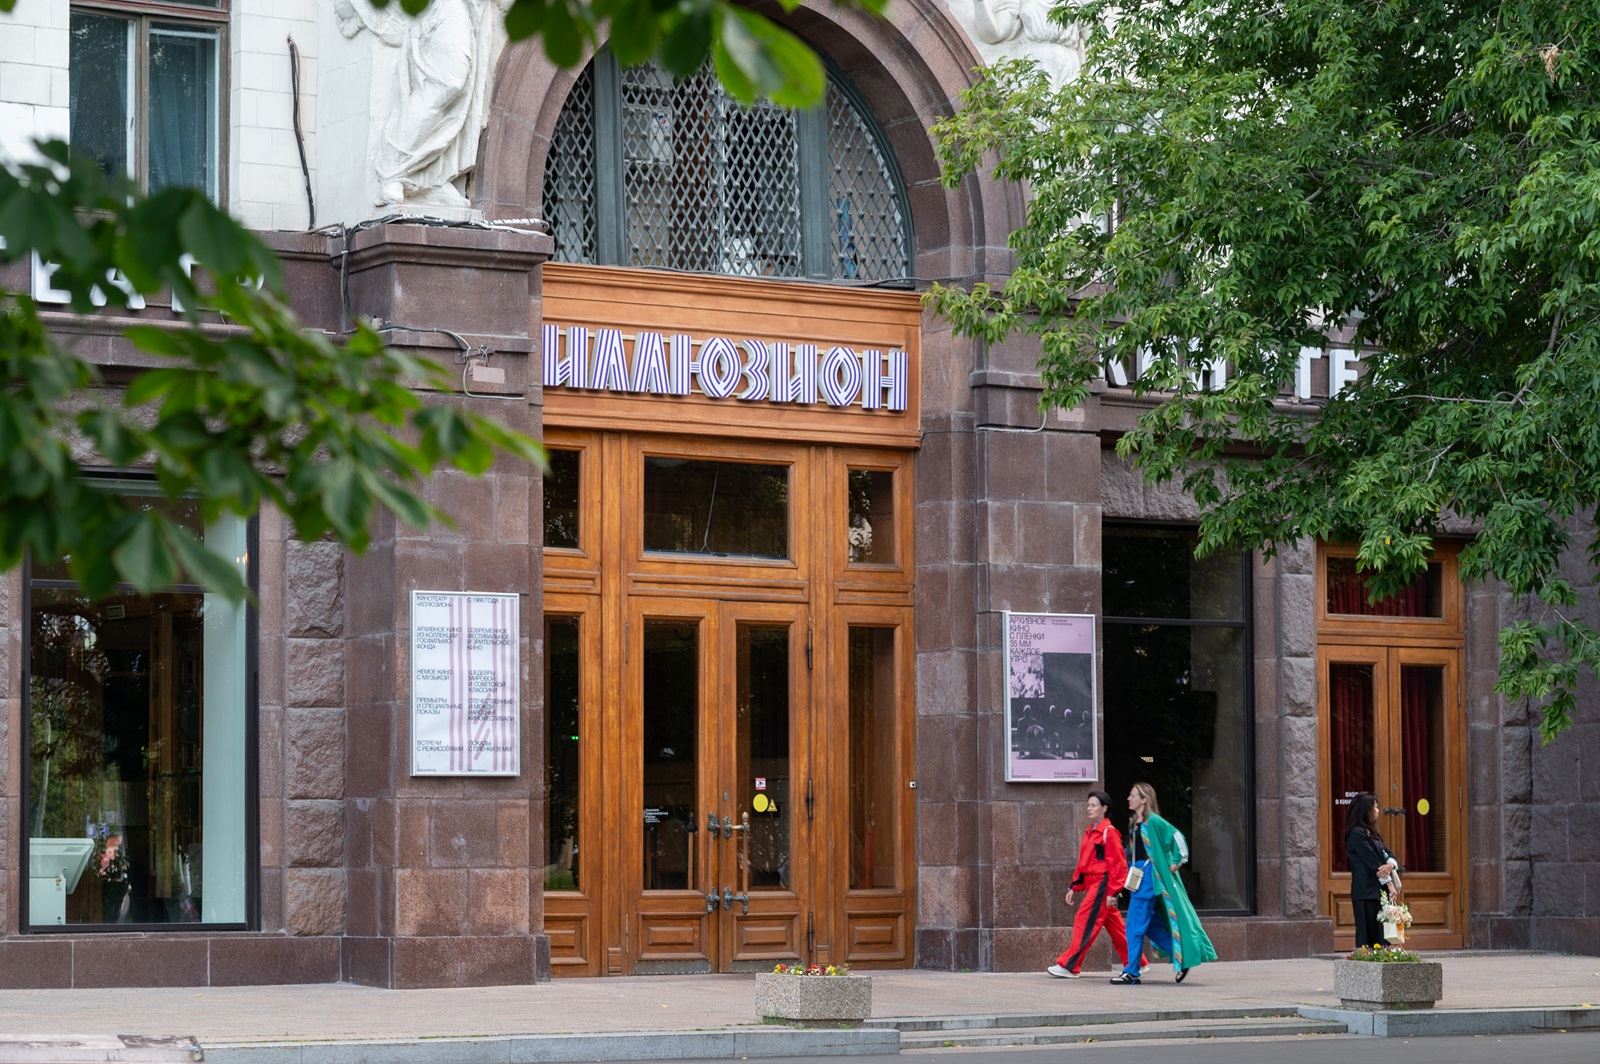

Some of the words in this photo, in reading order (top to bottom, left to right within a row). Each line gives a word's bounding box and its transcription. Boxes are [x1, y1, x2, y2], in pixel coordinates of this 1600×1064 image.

[542, 324, 909, 410] ИЛЛЮЗИОН
[1009, 617, 1046, 625] АРХИВНОЕ
[1009, 632, 1016, 640] С
[1009, 648, 1041, 656] КАЖДОЕ
